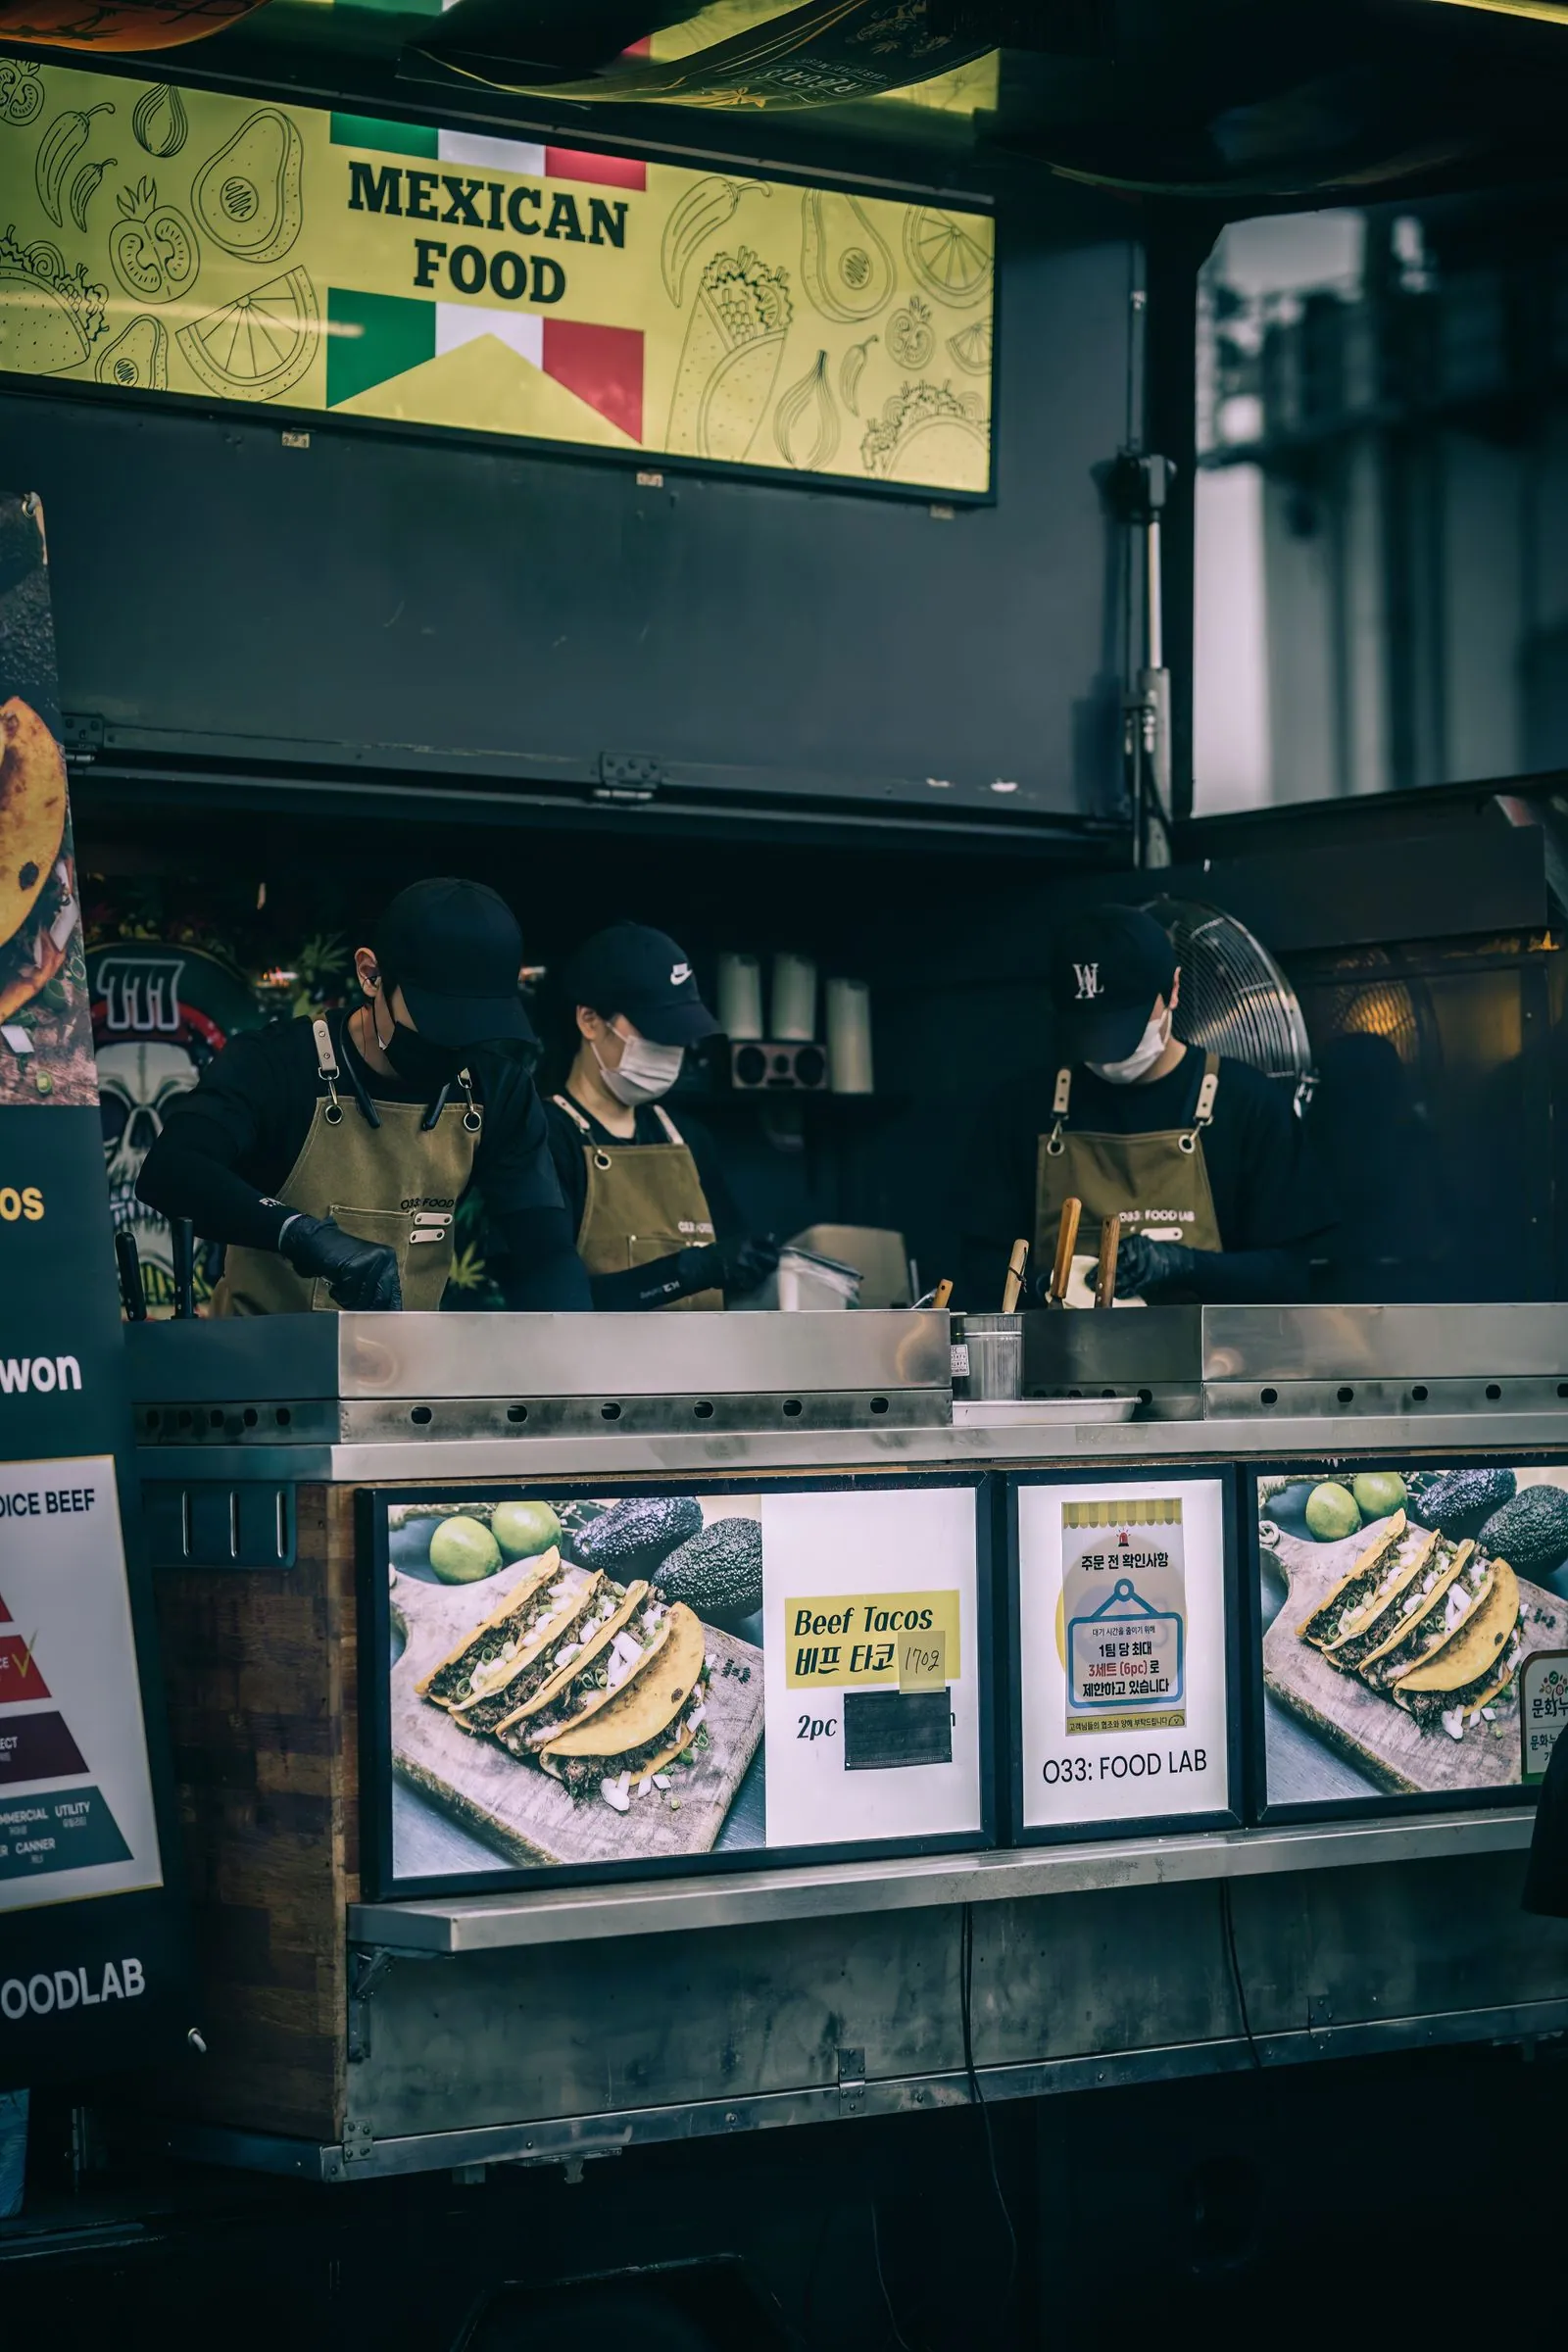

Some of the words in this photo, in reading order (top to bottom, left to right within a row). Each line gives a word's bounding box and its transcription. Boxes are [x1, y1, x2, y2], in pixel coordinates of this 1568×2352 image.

[348, 161, 629, 249] MEXICAN
[414, 238, 565, 304] FOOD
[421, 1198, 455, 1208] FOOD
[1145, 1209, 1177, 1221] FOOD
[0, 1355, 82, 1394] won
[45, 1489, 95, 1514] BEEF
[1081, 1555, 1104, 1571] 주문
[1107, 1553, 1119, 1570] 전
[1122, 1552, 1169, 1569] 확인사항
[794, 1607, 856, 1637] Beef
[863, 1606, 934, 1634] Tacos
[795, 1646, 842, 1676] 비프
[849, 1642, 896, 1673] 타코
[1099, 1643, 1116, 1657] 1팀
[1118, 1642, 1130, 1657] 당
[1132, 1641, 1152, 1656] 최대
[1088, 1662, 1117, 1678] 3세트
[1150, 1659, 1159, 1674] 로
[1082, 1681, 1126, 1697] 제한하고
[1129, 1678, 1169, 1694] 있습니다
[797, 1714, 838, 1740] 2pc
[1100, 1752, 1161, 1780] FOOD
[1168, 1748, 1207, 1774] LAB
[55, 1801, 90, 1818] UTILITY
[16, 1838, 56, 1854] CANNER
[1, 1957, 146, 2020] OODLAB
